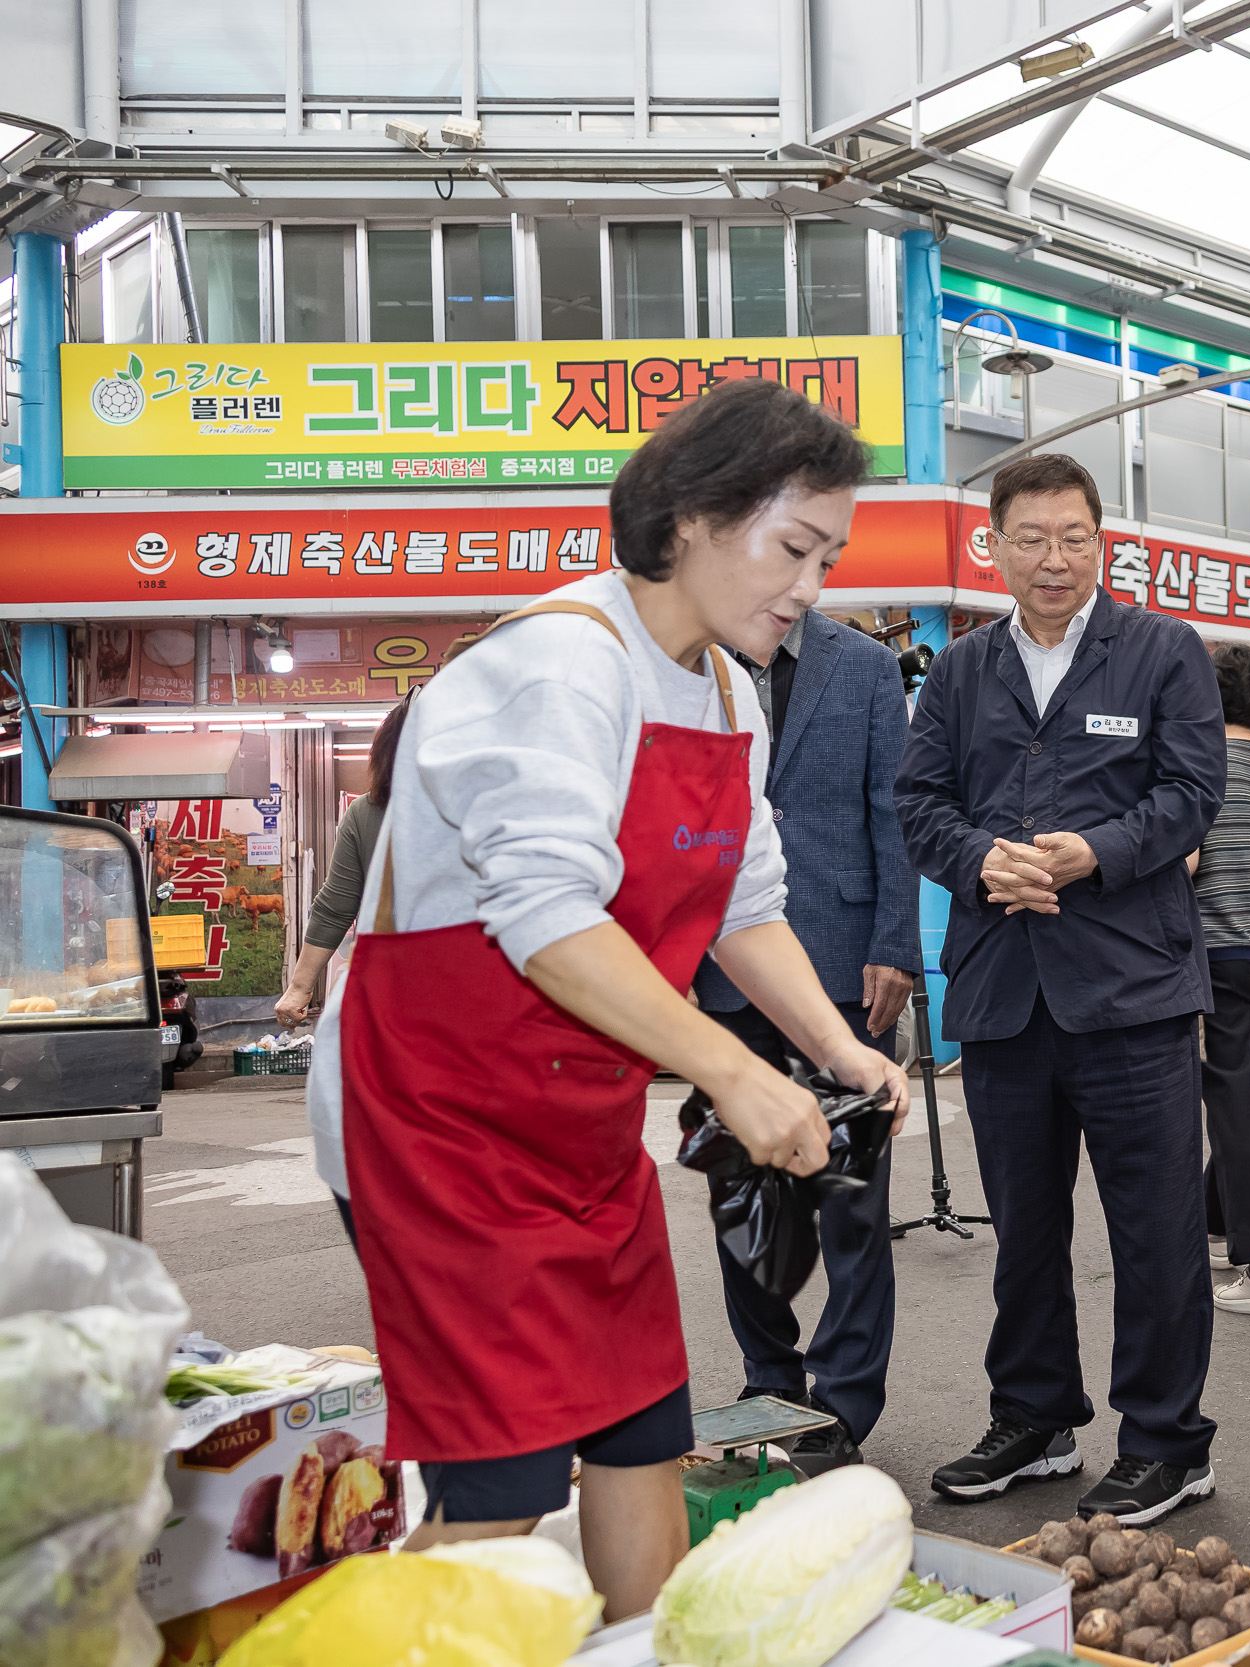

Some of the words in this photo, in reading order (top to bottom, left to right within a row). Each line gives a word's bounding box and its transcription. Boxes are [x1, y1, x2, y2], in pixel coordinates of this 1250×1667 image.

[150, 361, 270, 401] 그리다
[190, 395, 282, 421] 플러렌
[304, 360, 541, 437] 그리다
[265, 460, 322, 480] 그리다
[326, 460, 384, 479] 플러렌
[391, 457, 488, 478] 무료체험실
[500, 456, 574, 477] 중곡지점
[194, 527, 622, 577] 형제축산물도매센
[136, 579, 168, 590] 138호
